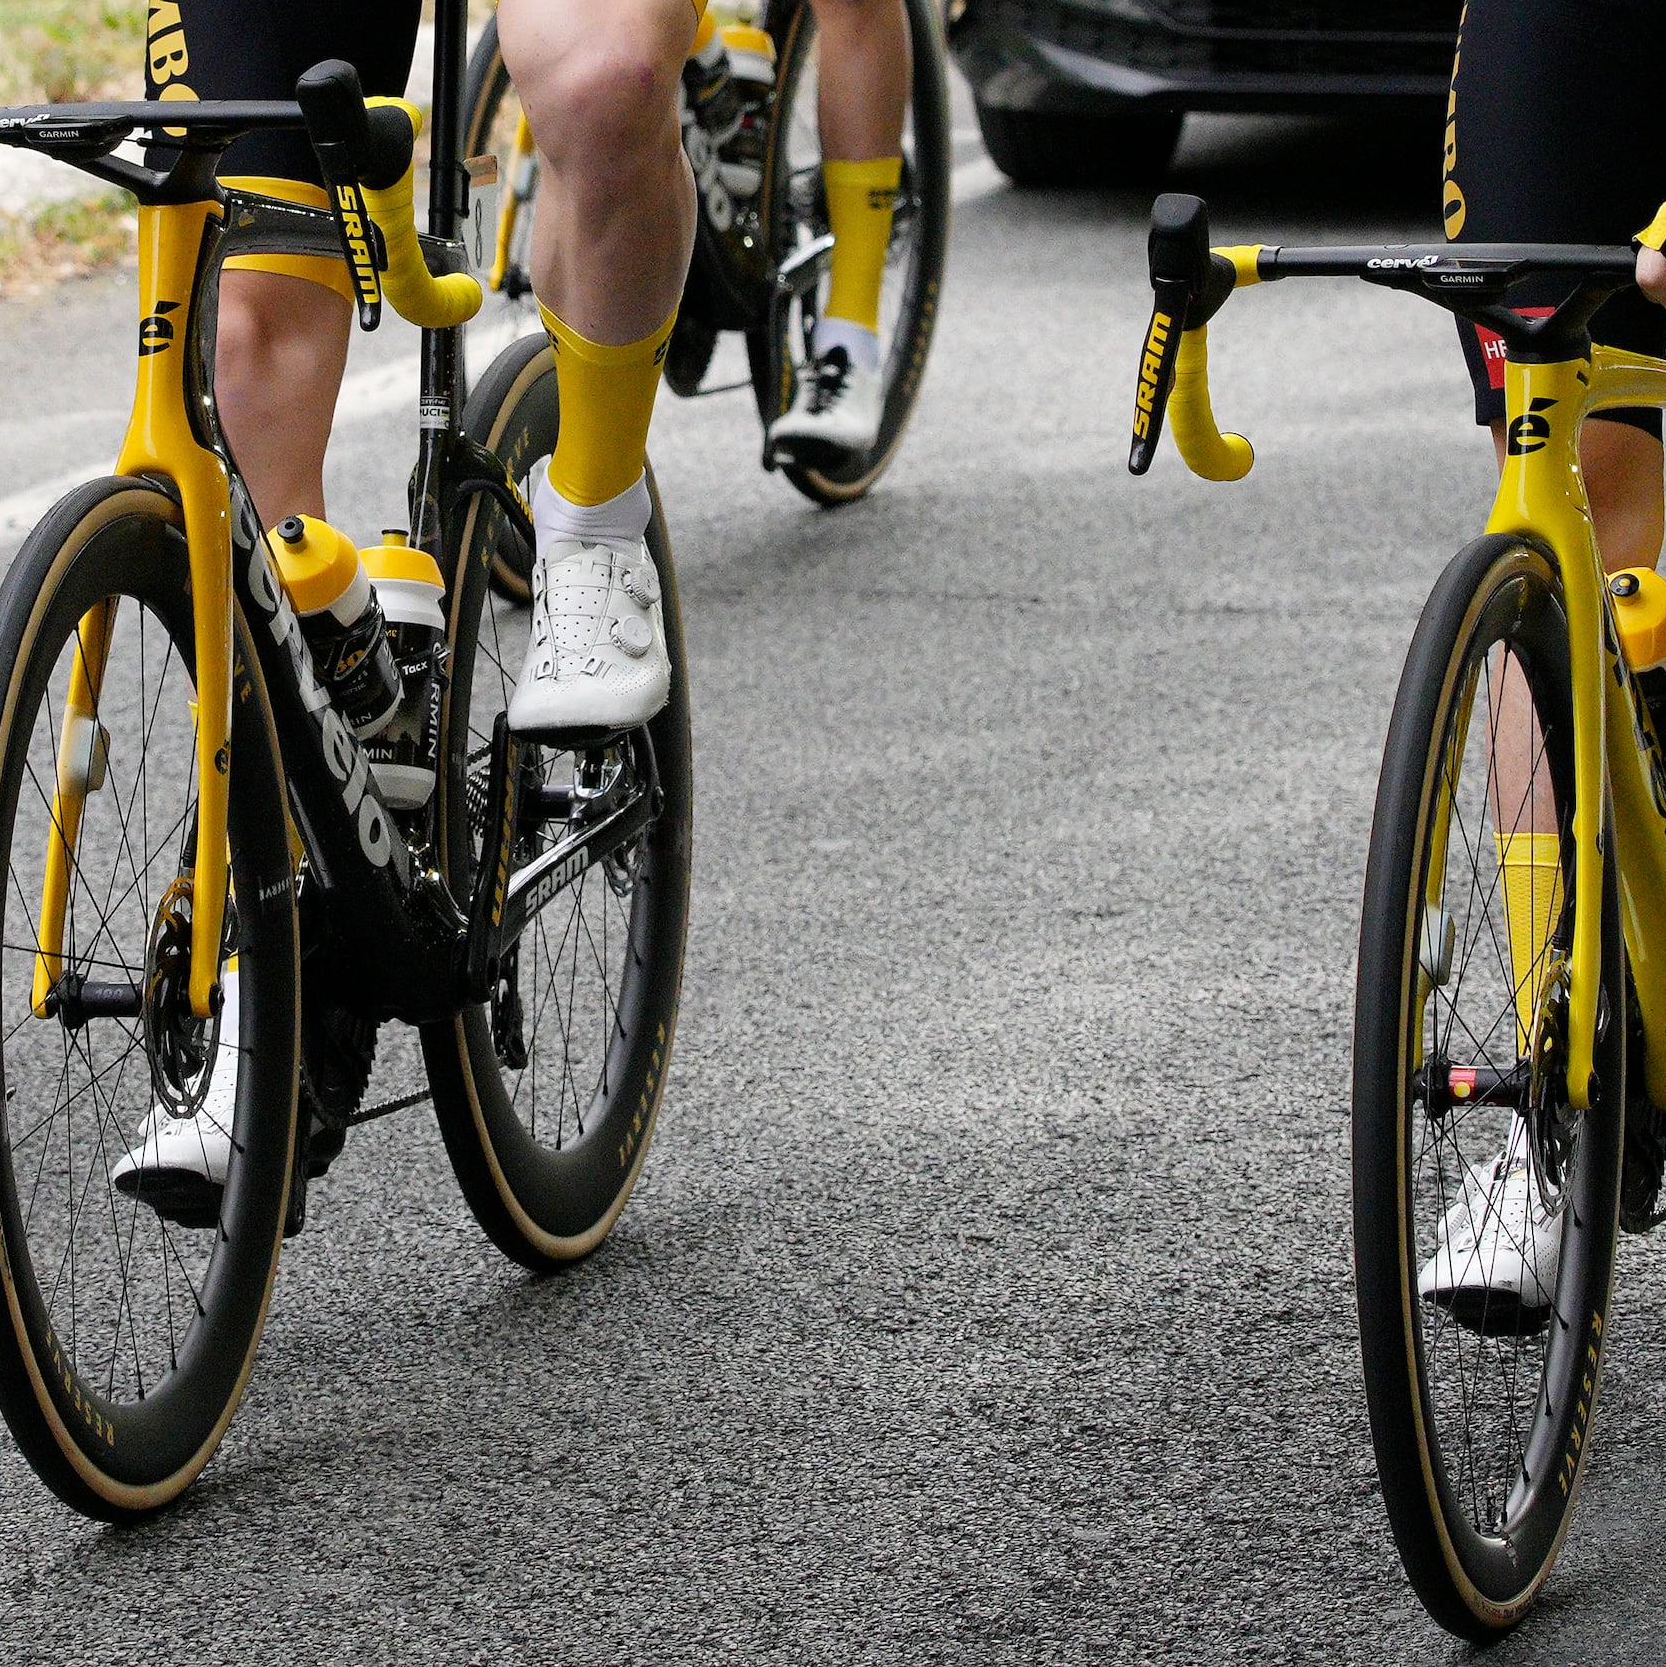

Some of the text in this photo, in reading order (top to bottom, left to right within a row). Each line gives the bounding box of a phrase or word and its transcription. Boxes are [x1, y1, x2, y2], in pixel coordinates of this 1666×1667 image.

[38, 130, 79, 139] GARMIN
[336, 185, 380, 304] SRAM
[1367, 254, 1439, 269] cervél
[1440, 274, 1484, 283] GARMIN
[1485, 339, 1509, 360] HE
[1133, 311, 1172, 441] SRAM
[402, 660, 428, 676] Tacx
[427, 683, 440, 759] RMIN
[363, 747, 393, 760] MIN
[526, 845, 590, 916] SRAM
[1558, 1309, 1605, 1499] RESERVE
